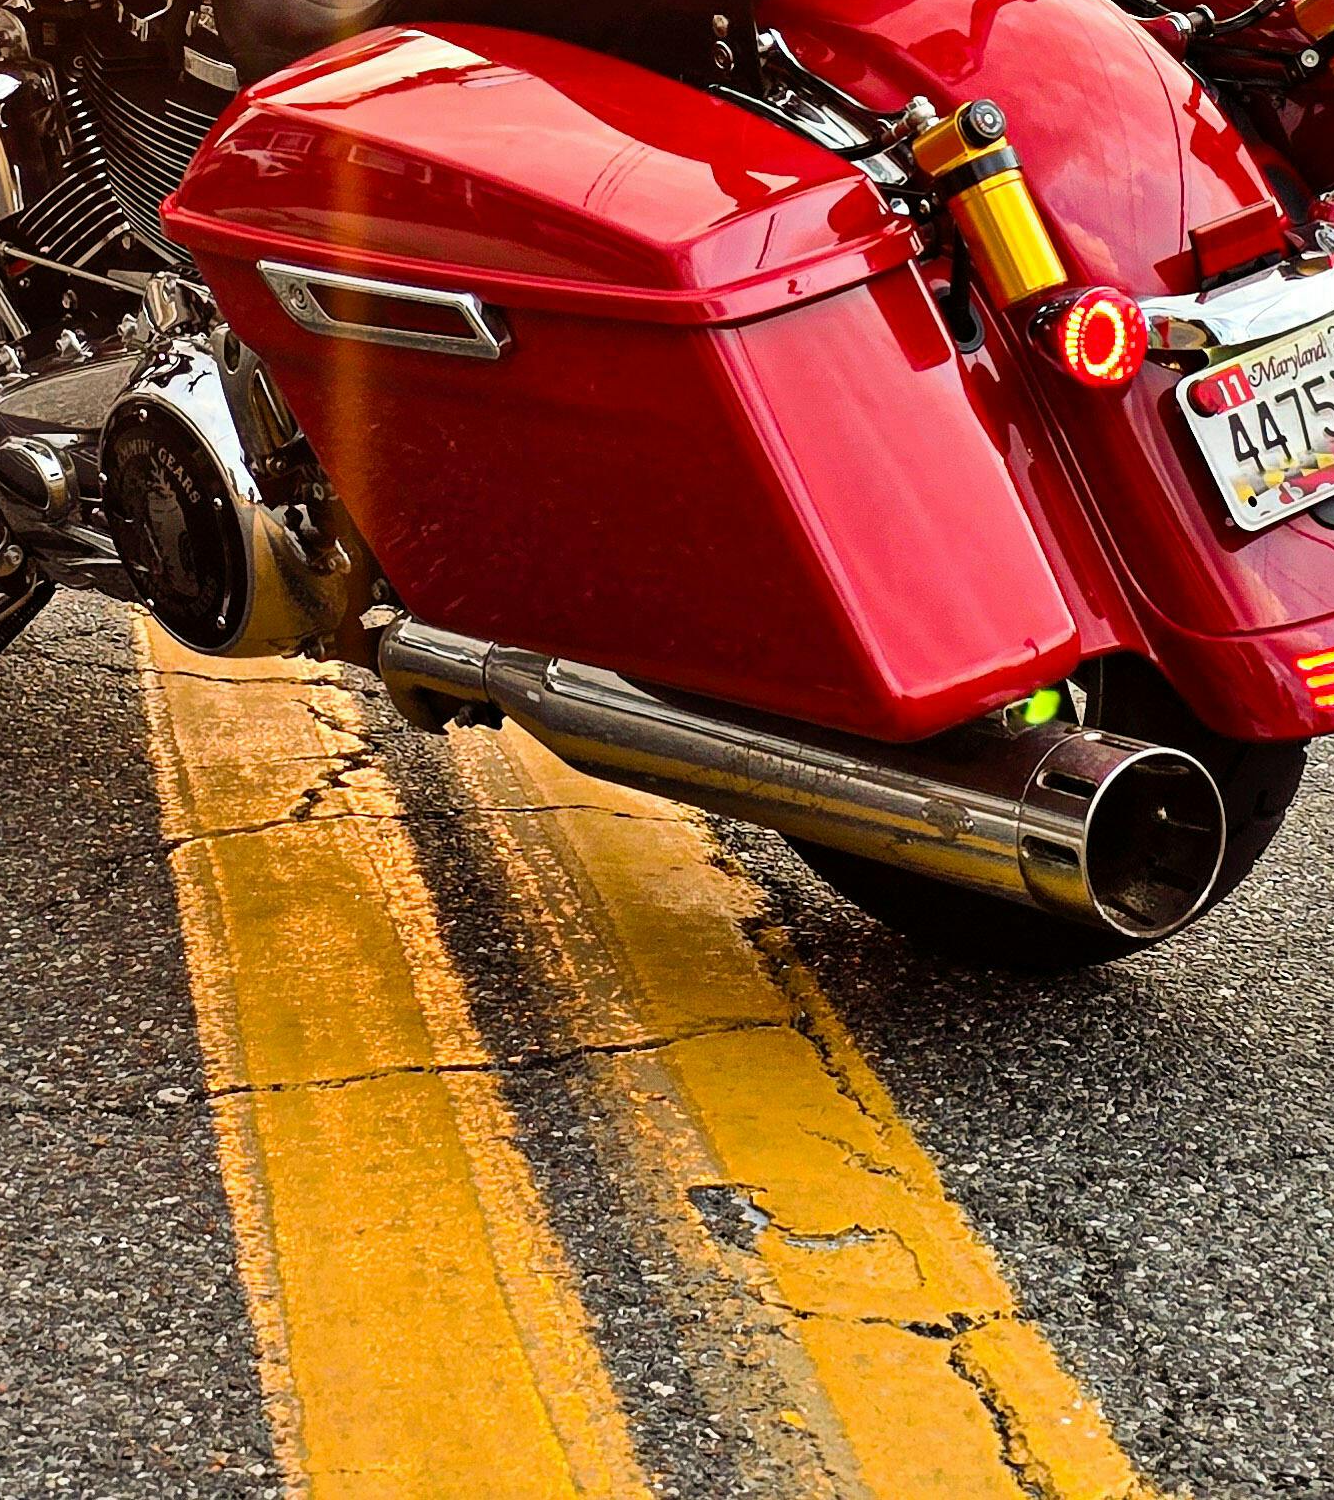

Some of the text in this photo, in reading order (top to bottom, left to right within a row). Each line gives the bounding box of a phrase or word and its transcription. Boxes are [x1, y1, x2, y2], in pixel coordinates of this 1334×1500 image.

[1248, 331, 1327, 387] Maryland
[1218, 373, 1247, 407] 11
[157, 446, 201, 504] GEARS
